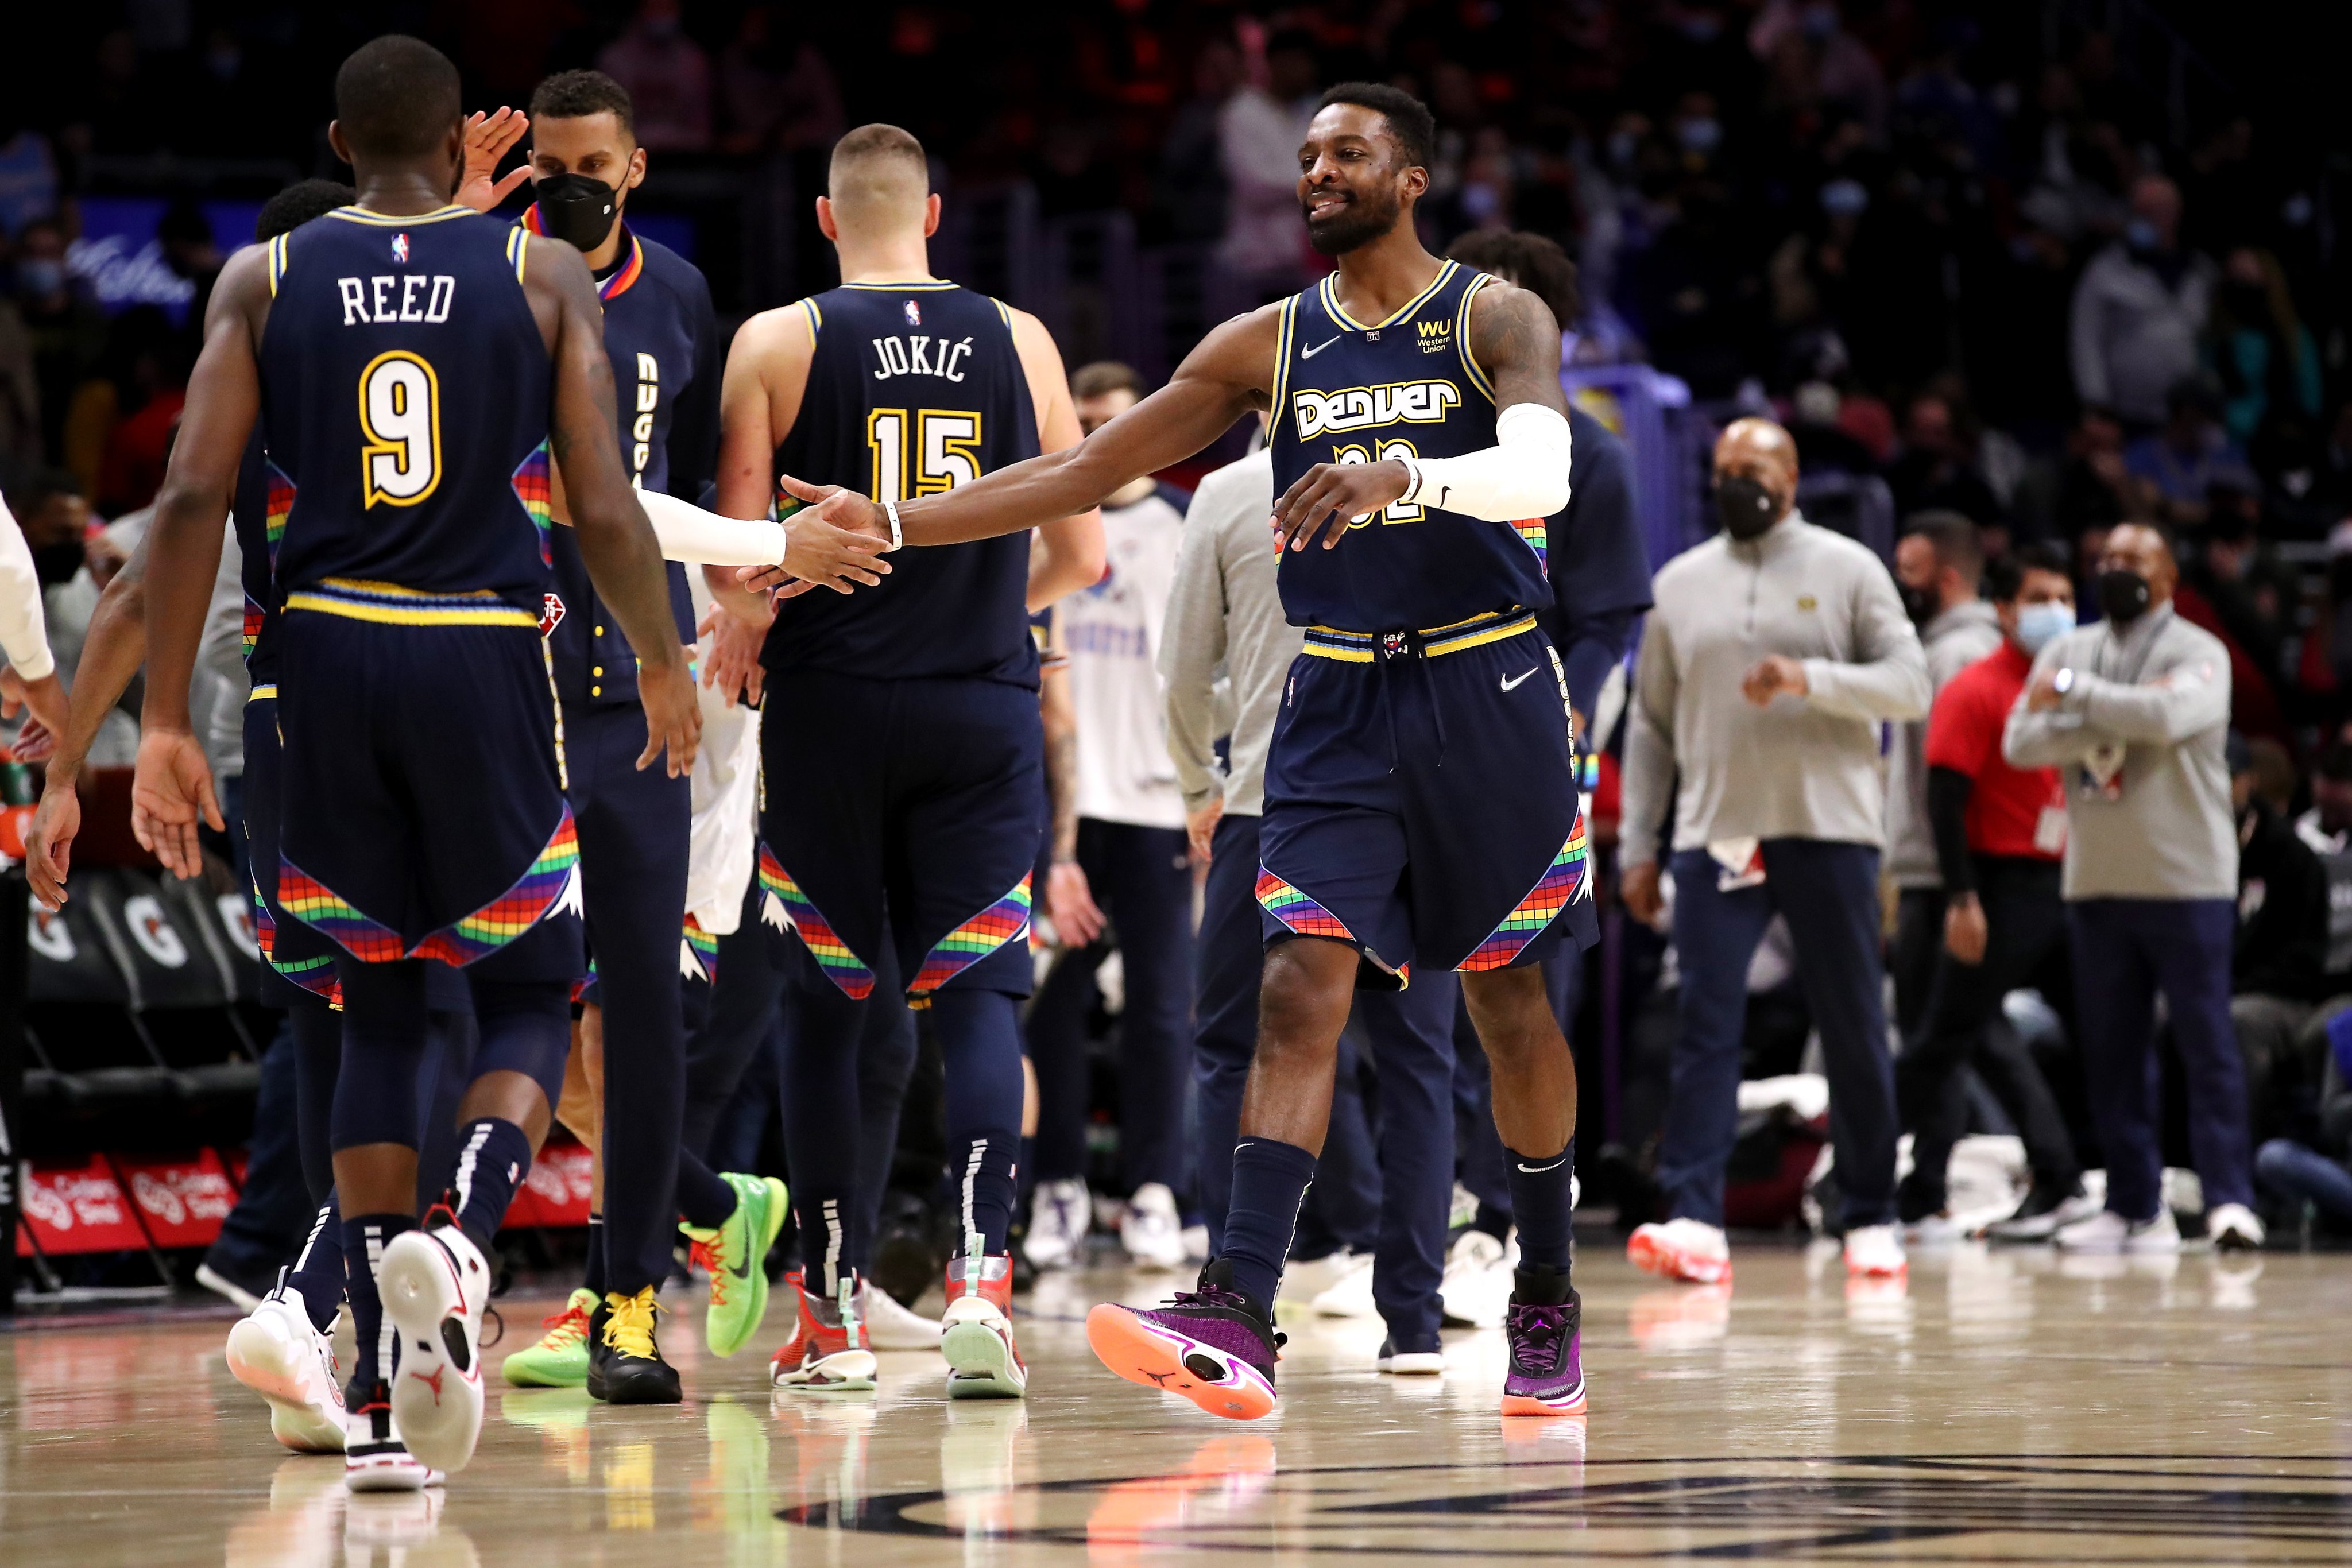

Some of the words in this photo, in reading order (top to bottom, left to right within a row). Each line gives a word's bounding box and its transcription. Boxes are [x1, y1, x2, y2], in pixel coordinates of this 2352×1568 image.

[338, 275, 455, 326] REED
[1417, 319, 1451, 337] WU
[1417, 336, 1450, 347] Western
[1423, 344, 1446, 354] Union
[872, 335, 973, 382] JOKIĆ
[359, 350, 442, 511] 9
[1293, 379, 1461, 443] Denver
[867, 408, 981, 503] 15
[544, 601, 555, 617] 75
[124, 894, 188, 969] G
